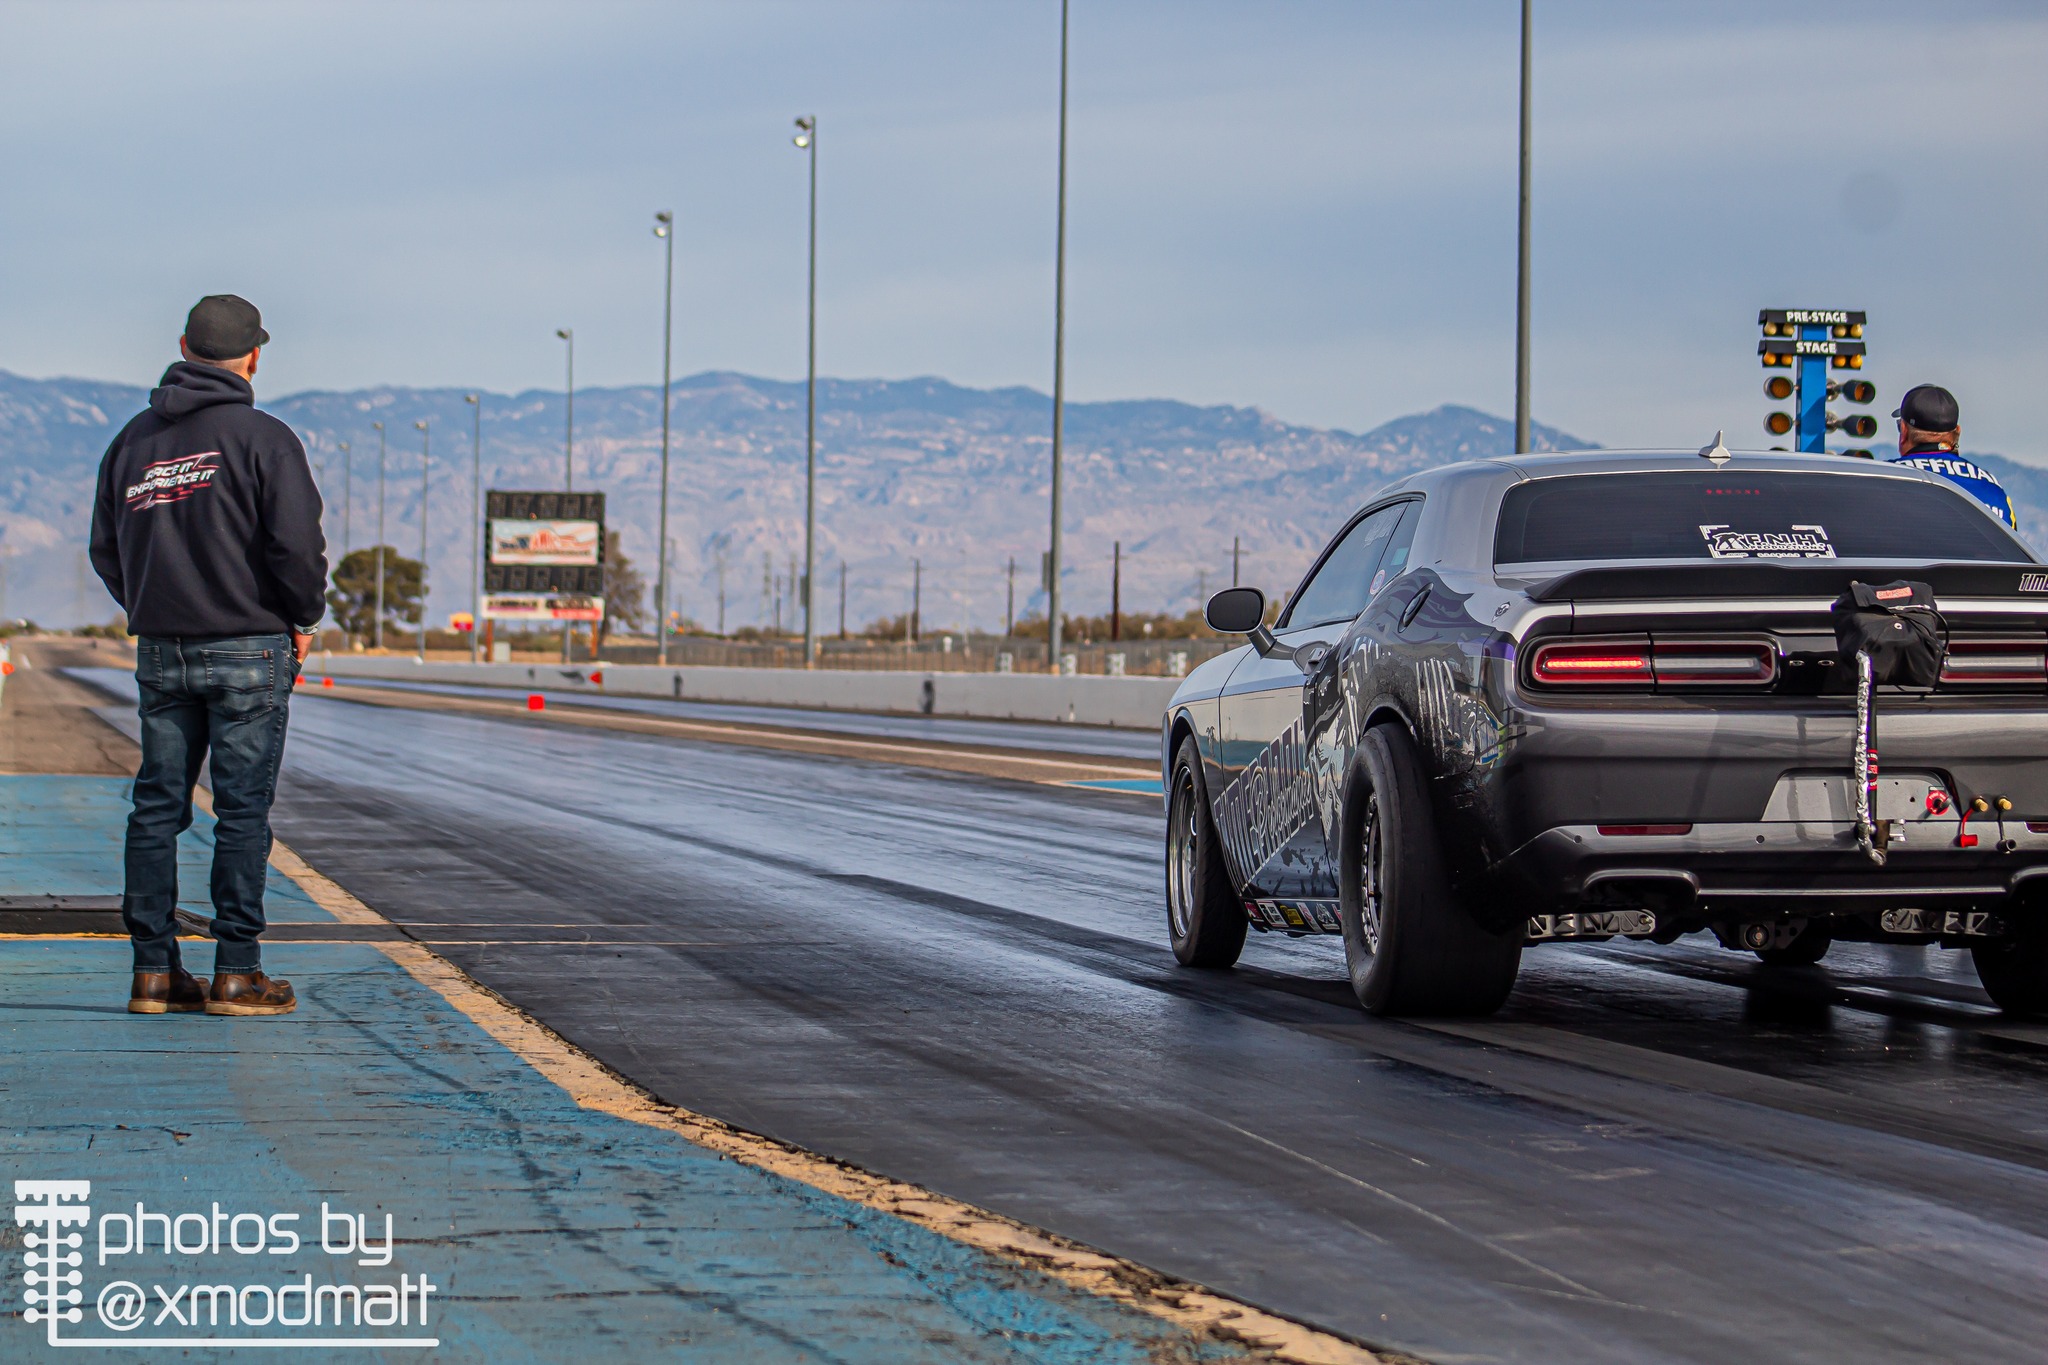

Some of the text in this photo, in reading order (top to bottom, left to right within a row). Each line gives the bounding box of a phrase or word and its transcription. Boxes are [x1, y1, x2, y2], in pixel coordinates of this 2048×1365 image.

[1786, 311, 1847, 324] PRE-STAGE
[1796, 342, 1837, 354] STAGE
[179, 461, 194, 474] IT
[126, 471, 201, 498] EXPERIENCE
[199, 469, 216, 481] IT
[2018, 573, 2048, 591] TIM
[1878, 588, 1909, 598] SIMPSON
